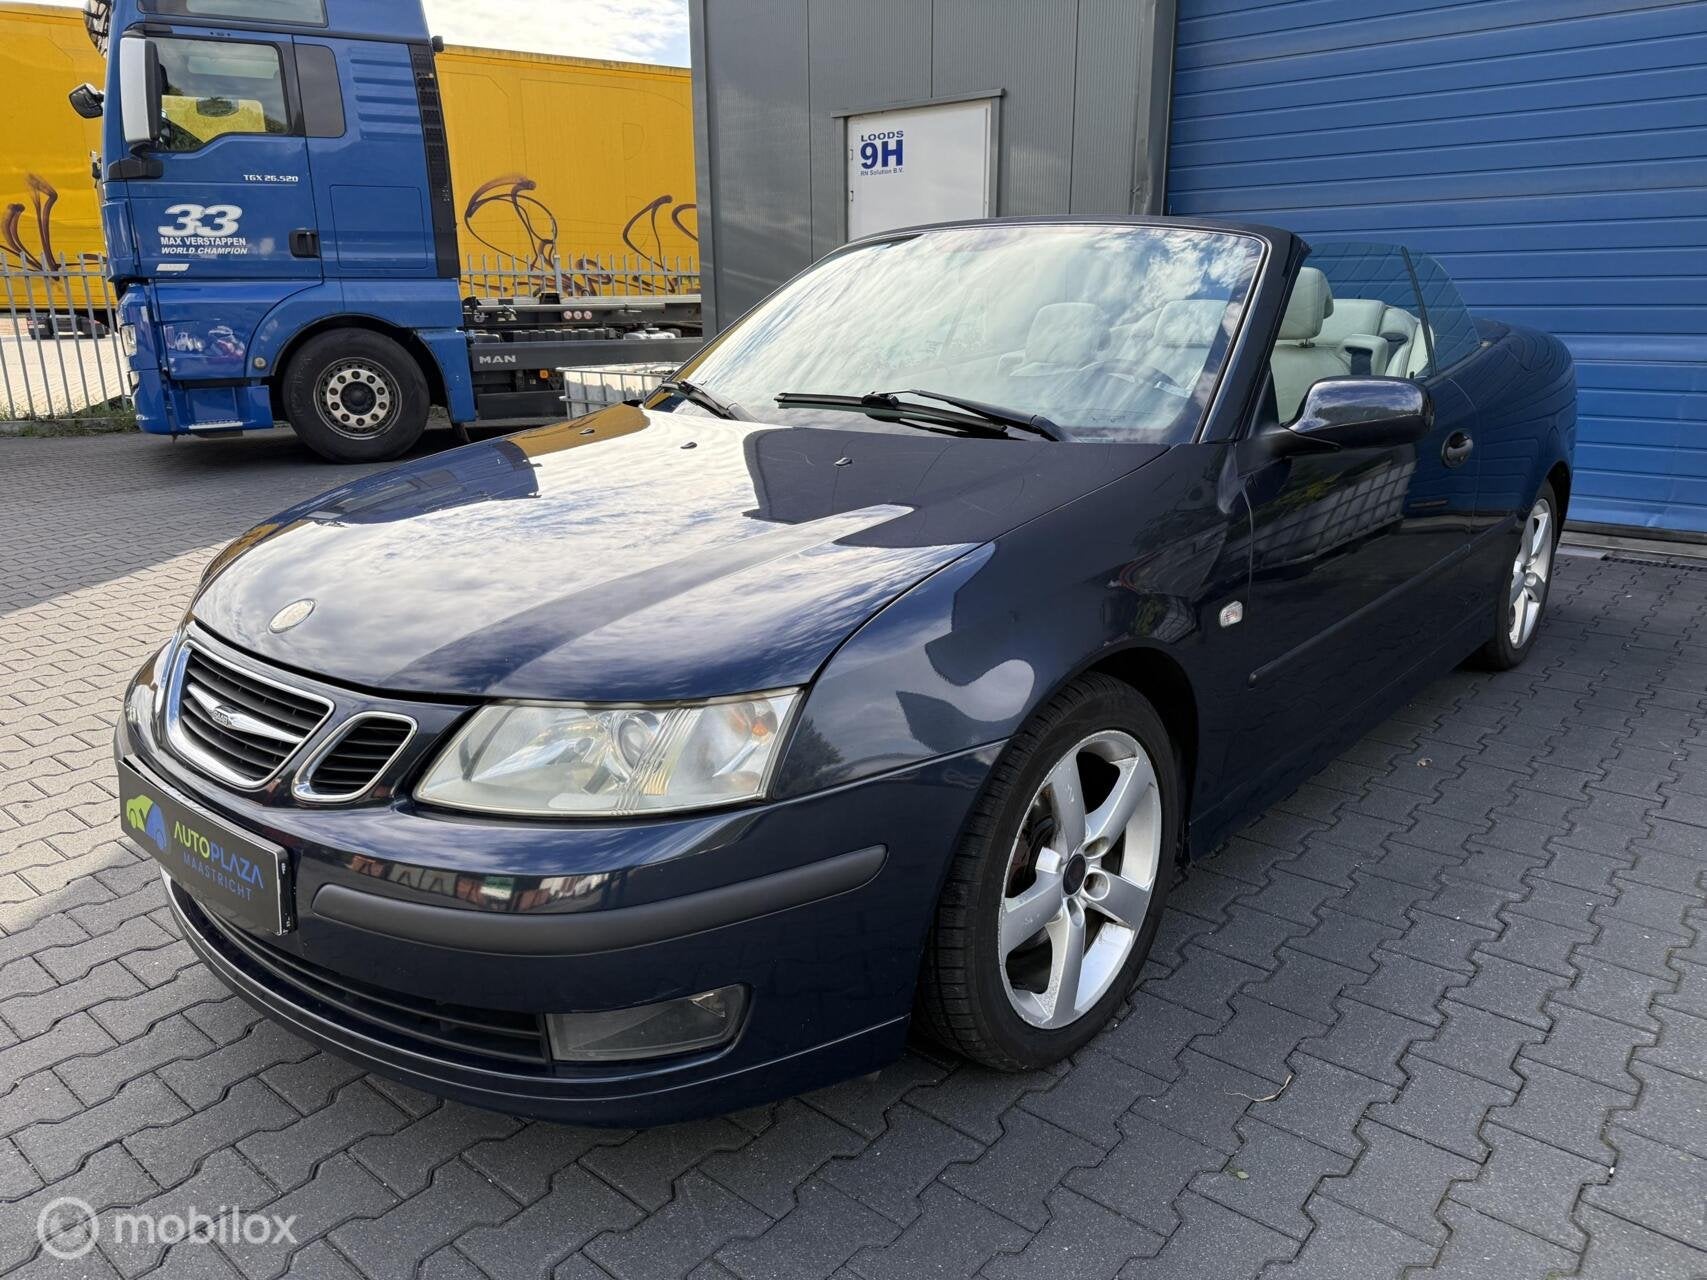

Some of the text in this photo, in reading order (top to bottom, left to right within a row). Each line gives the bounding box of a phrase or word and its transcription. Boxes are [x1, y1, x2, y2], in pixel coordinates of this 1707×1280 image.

[861, 130, 904, 142] LOODS
[860, 139, 903, 169] 9H
[264, 174, 299, 182] 26.520
[158, 203, 243, 237] 33
[160, 236, 247, 246] MAX VERSTAPPEN
[197, 247, 248, 255] CHAMPION
[479, 355, 517, 364] MAN
[183, 852, 253, 900] MAASTRICHT
